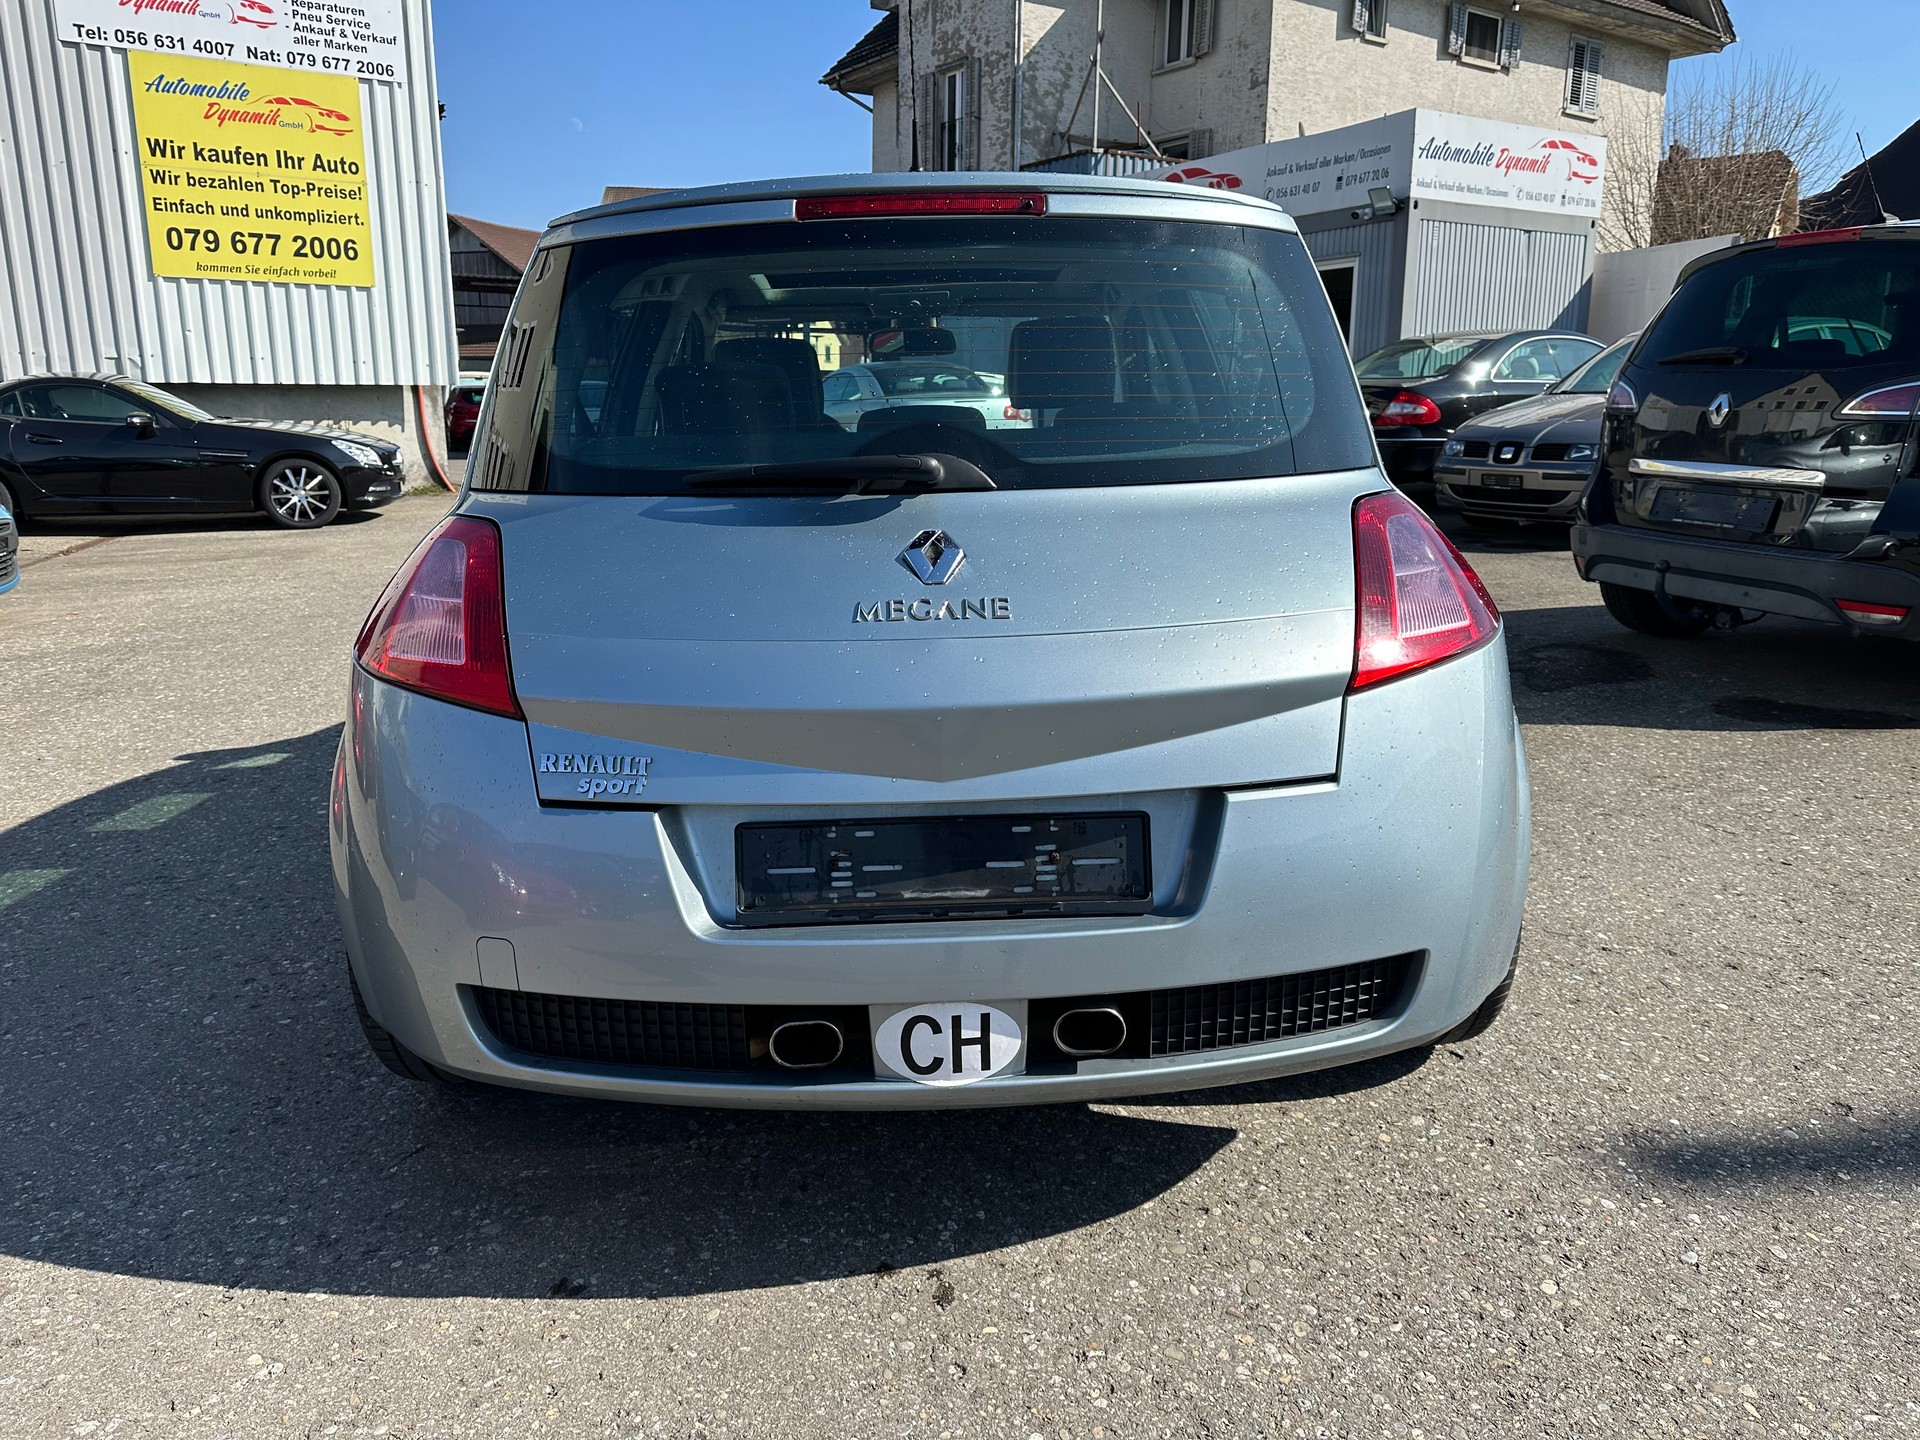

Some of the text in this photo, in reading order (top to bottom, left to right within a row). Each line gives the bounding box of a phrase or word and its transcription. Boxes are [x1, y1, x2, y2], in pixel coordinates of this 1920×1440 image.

[198, 10, 221, 19] GmbH
[291, 0, 365, 17] Reparaturen
[292, 9, 322, 23] Pneu
[326, 14, 371, 30] Service
[293, 22, 336, 37] Ankauf
[339, 29, 348, 38] &
[351, 30, 397, 46] Verkauf
[293, 35, 367, 54] aller Marken
[73, 23, 395, 77] Tel: 056 631 4007 Nat: 079 677 2006
[144, 73, 250, 102] Automobile
[203, 102, 304, 130] Dynamik GmbH
[146, 137, 360, 176] Wir kaufen Ihr Auto
[1266, 163, 1288, 178] Ankauf
[1288, 164, 1294, 174] &
[1295, 157, 1319, 173] Verkauf
[1319, 156, 1332, 168] aller
[1418, 136, 1552, 178] Automobile Dynamik
[149, 168, 363, 201] Wir bezahlen Top-Preise!
[1345, 174, 1358, 187] 079
[1358, 171, 1371, 184] 677
[1380, 167, 1390, 179] 06
[1276, 181, 1320, 199] 056 631 40 07
[152, 197, 365, 226] Einfach und unkompliziert.
[166, 226, 359, 261] 079 677 2006
[196, 262, 337, 279] kommen Sie einfach vorbei!
[851, 596, 1014, 624] MEGANE
[539, 753, 653, 776] RENAULT
[576, 775, 648, 799] sport
[899, 1011, 993, 1076] CH
